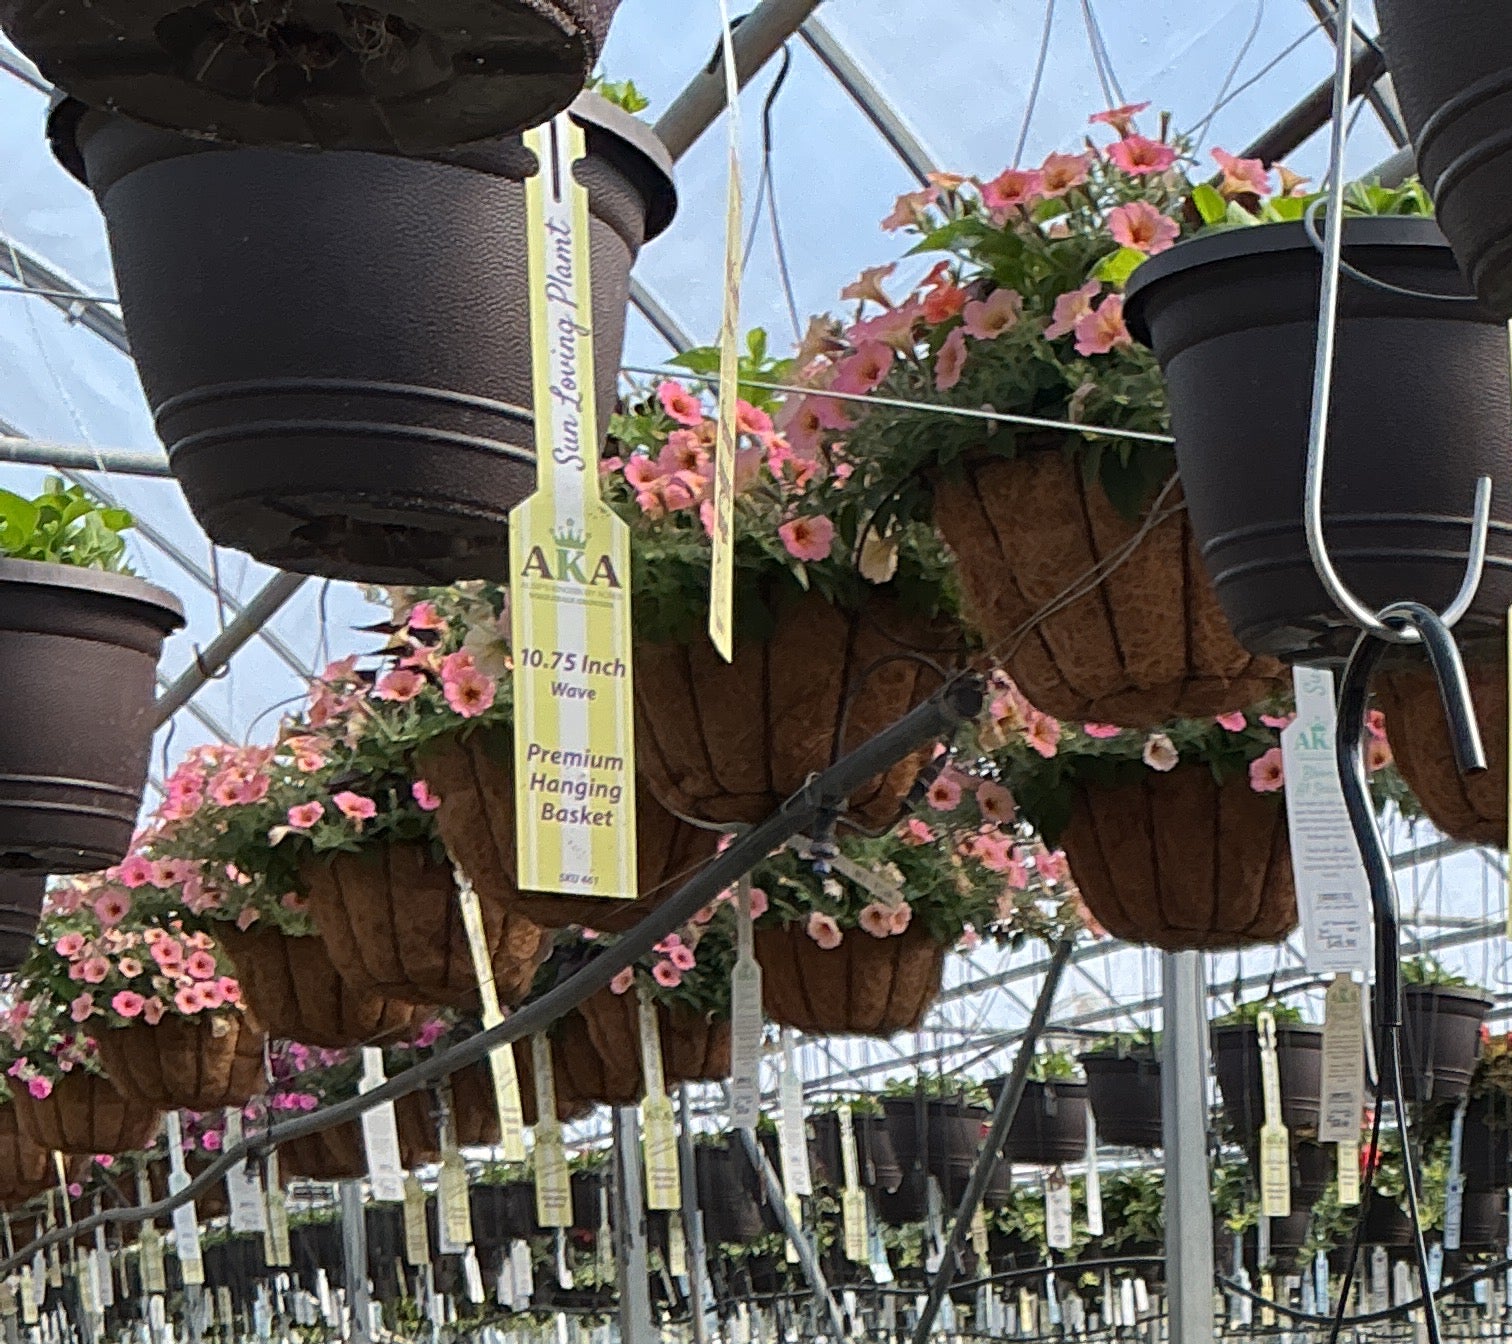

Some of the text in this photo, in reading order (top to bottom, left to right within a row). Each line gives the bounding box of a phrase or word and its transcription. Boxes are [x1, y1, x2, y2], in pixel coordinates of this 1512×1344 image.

[549, 313, 591, 413] Loving
[552, 412, 586, 471] Sun
[520, 545, 623, 589] AKA
[520, 648, 627, 678] 10.75 Inch
[551, 681, 597, 701] Wave
[1294, 731, 1329, 750] AK
[527, 743, 624, 772] Premium
[529, 772, 623, 805] Hanging
[540, 802, 614, 827] Basket
